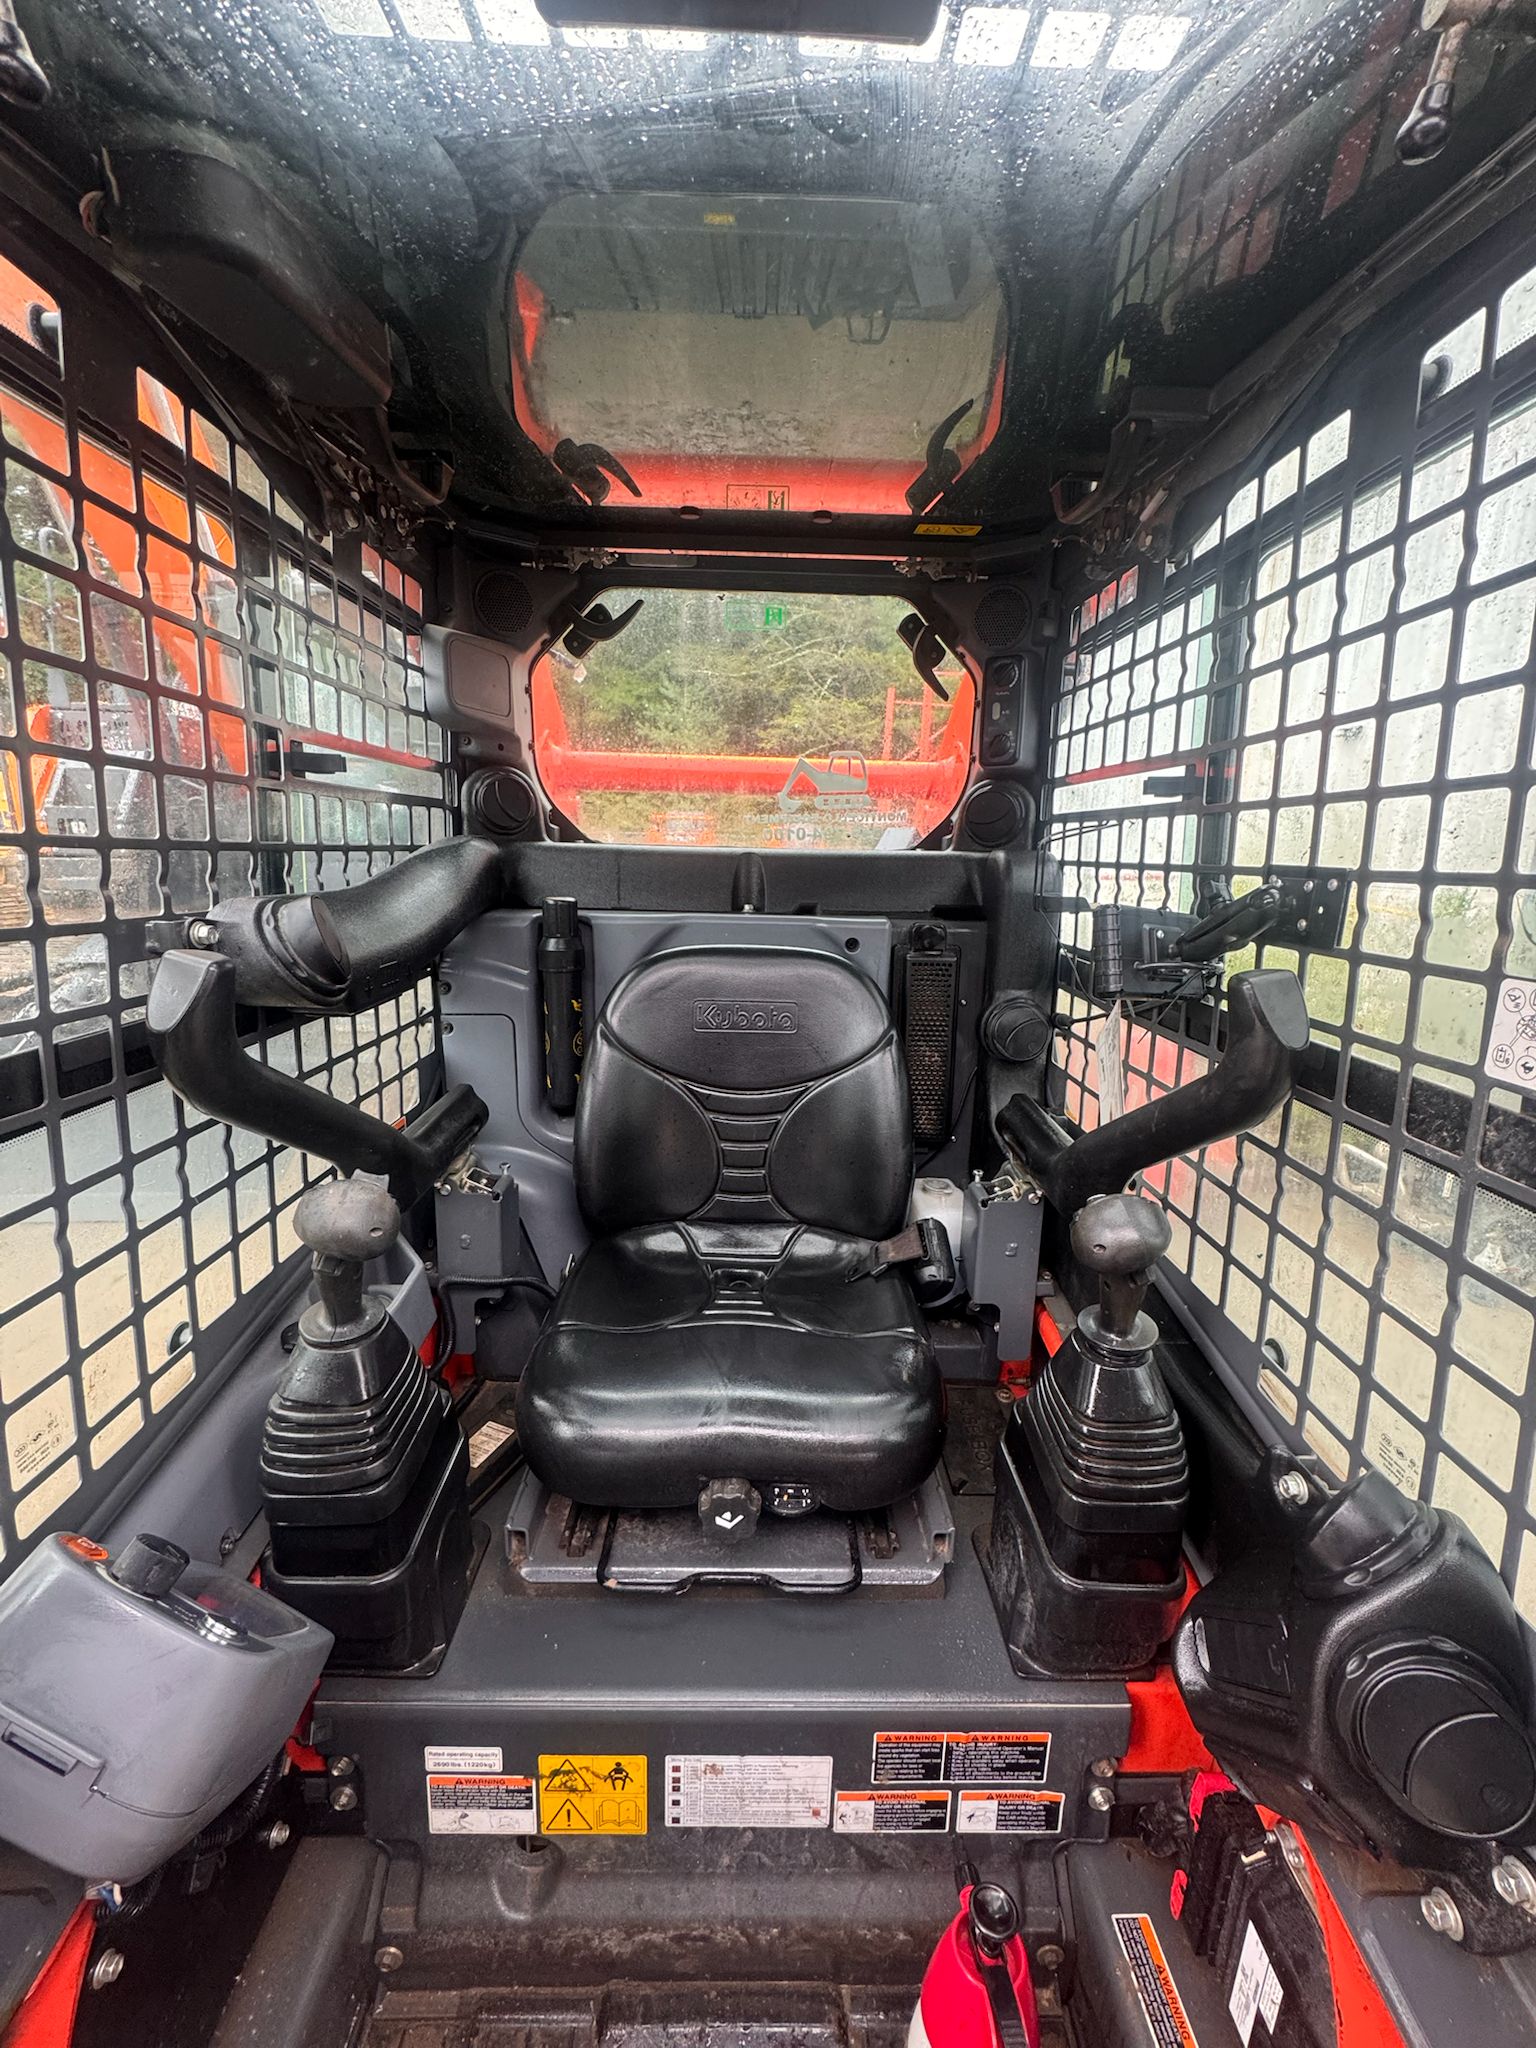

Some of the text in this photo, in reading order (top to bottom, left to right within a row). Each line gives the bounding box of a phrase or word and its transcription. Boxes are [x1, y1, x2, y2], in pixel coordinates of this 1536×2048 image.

[696, 1004, 793, 1030] Kubota
[971, 1440, 993, 1471] BOX
[1162, 1977, 1191, 2040] WARNING
